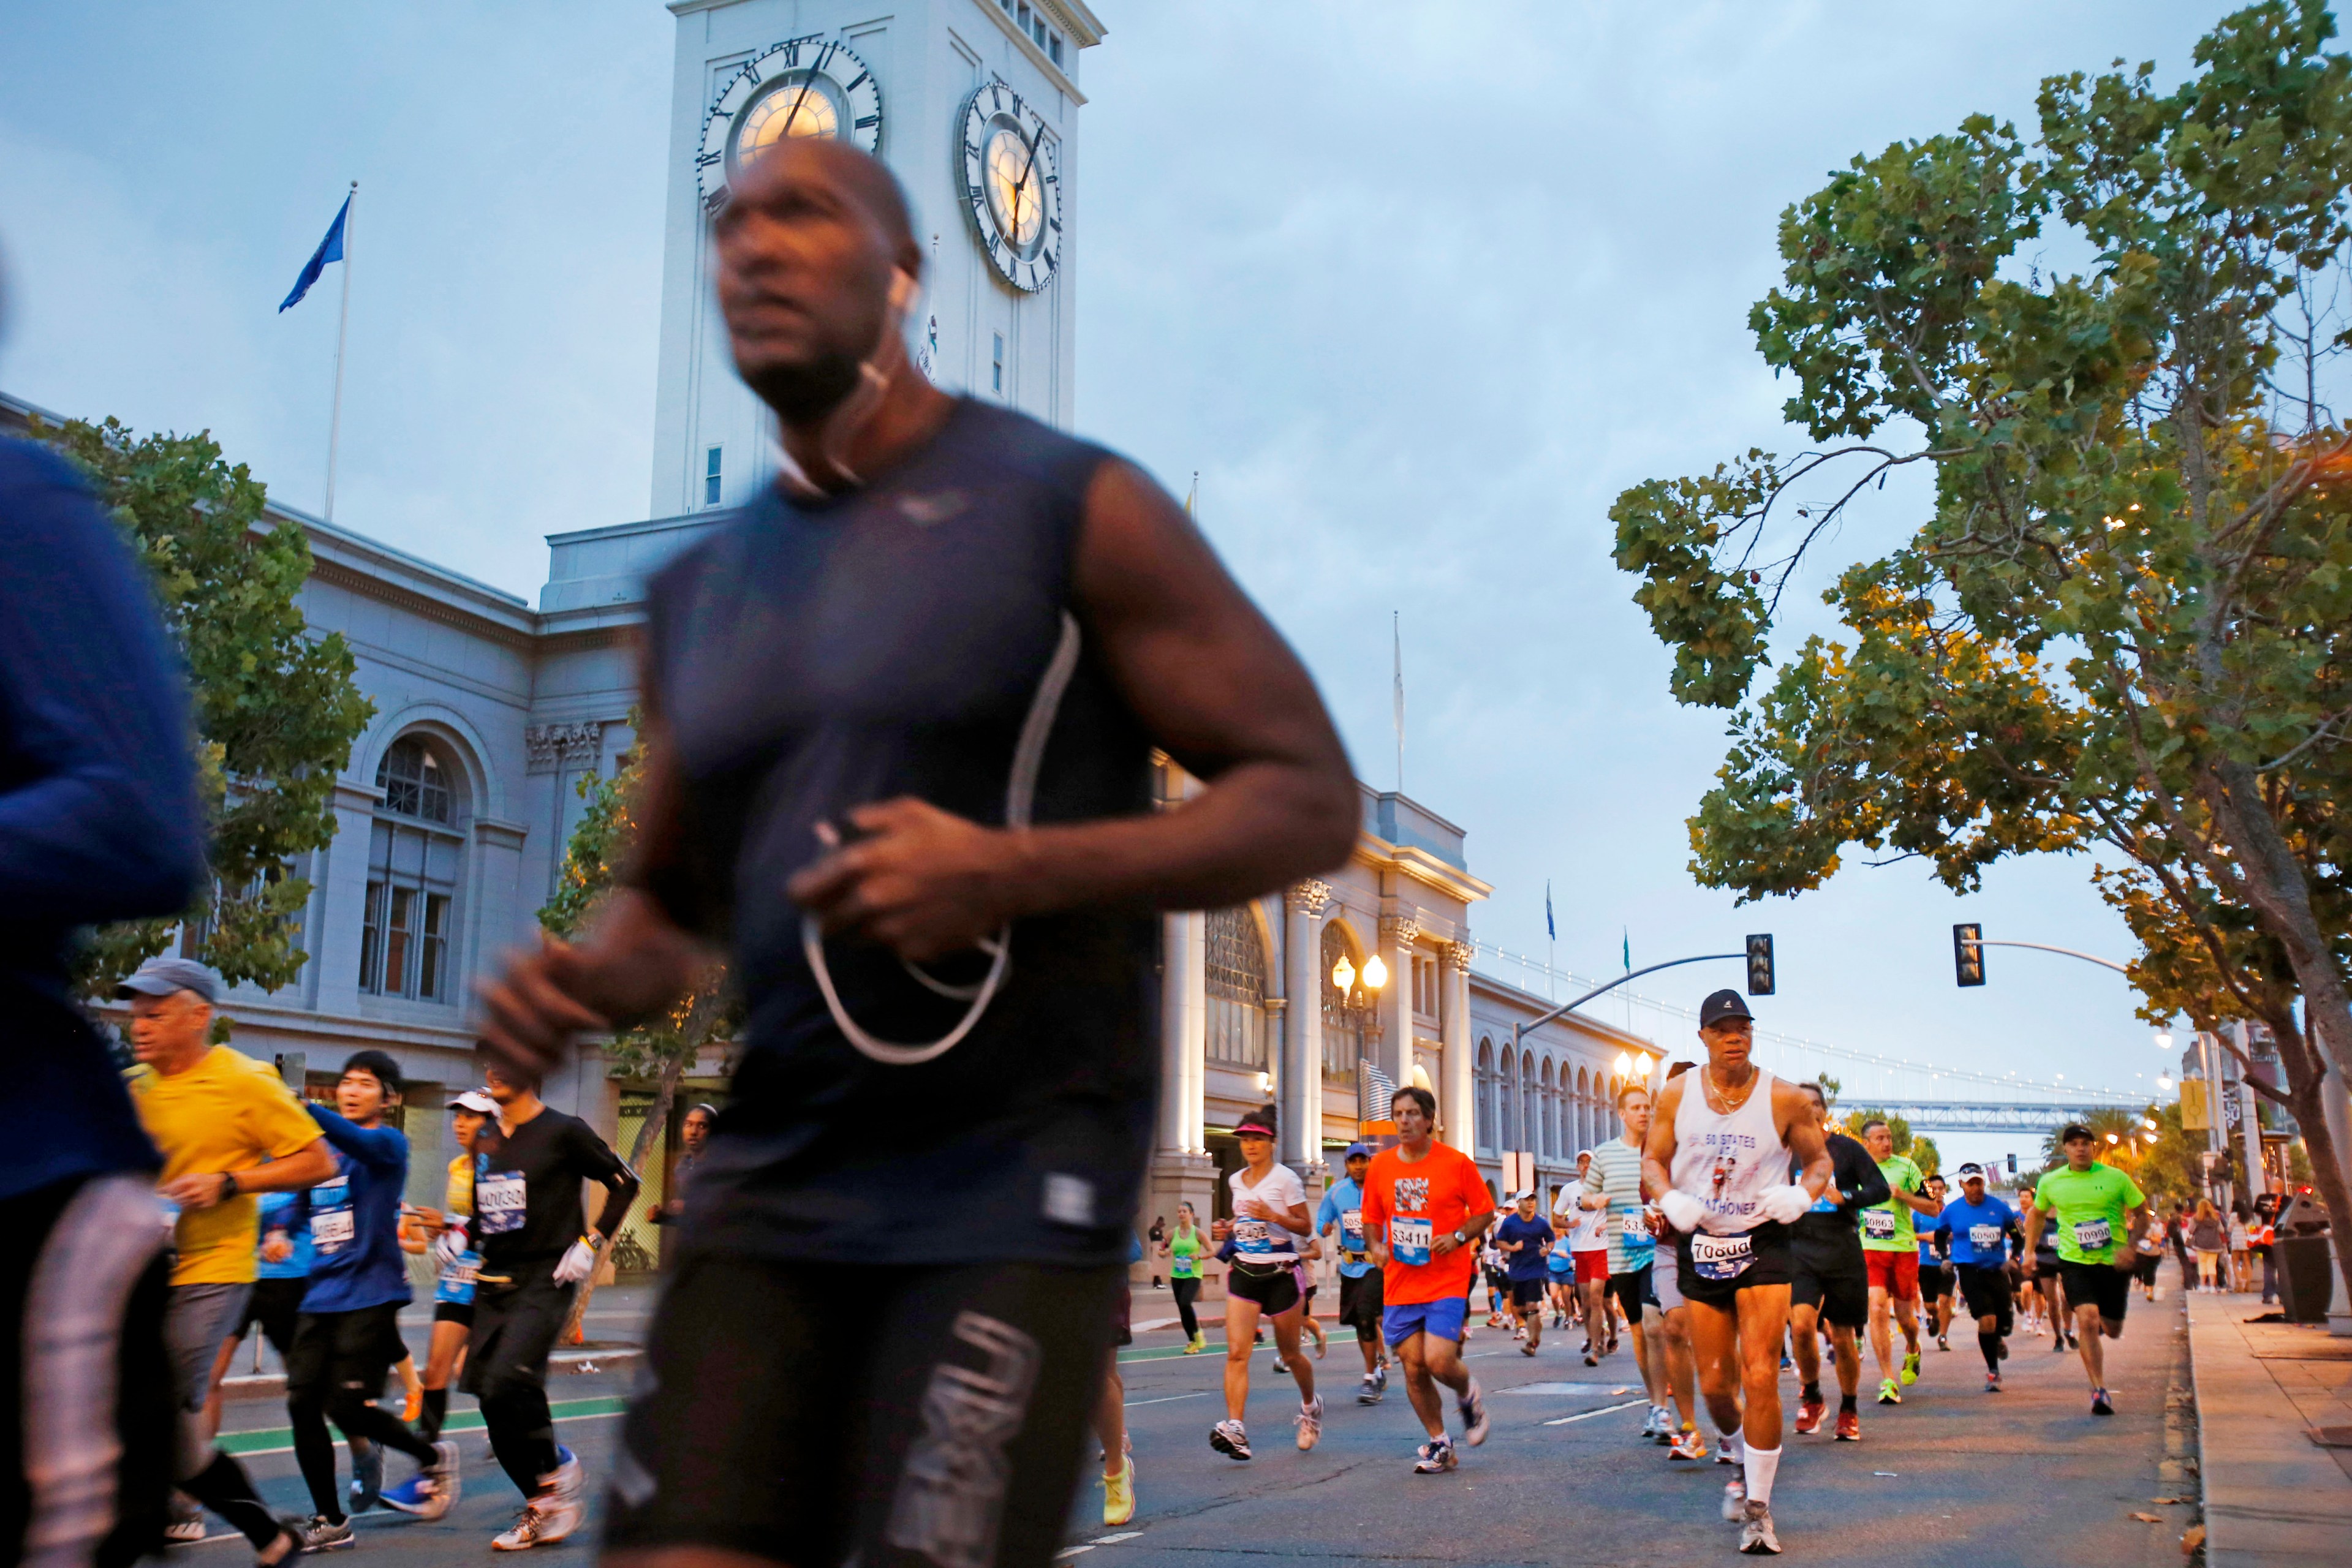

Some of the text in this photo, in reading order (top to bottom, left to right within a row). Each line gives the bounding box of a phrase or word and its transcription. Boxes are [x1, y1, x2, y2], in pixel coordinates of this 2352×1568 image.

[1721, 1134, 1755, 1148] STATES
[1393, 1230, 1429, 1246] 53411
[2078, 1227, 2111, 1242] 70990
